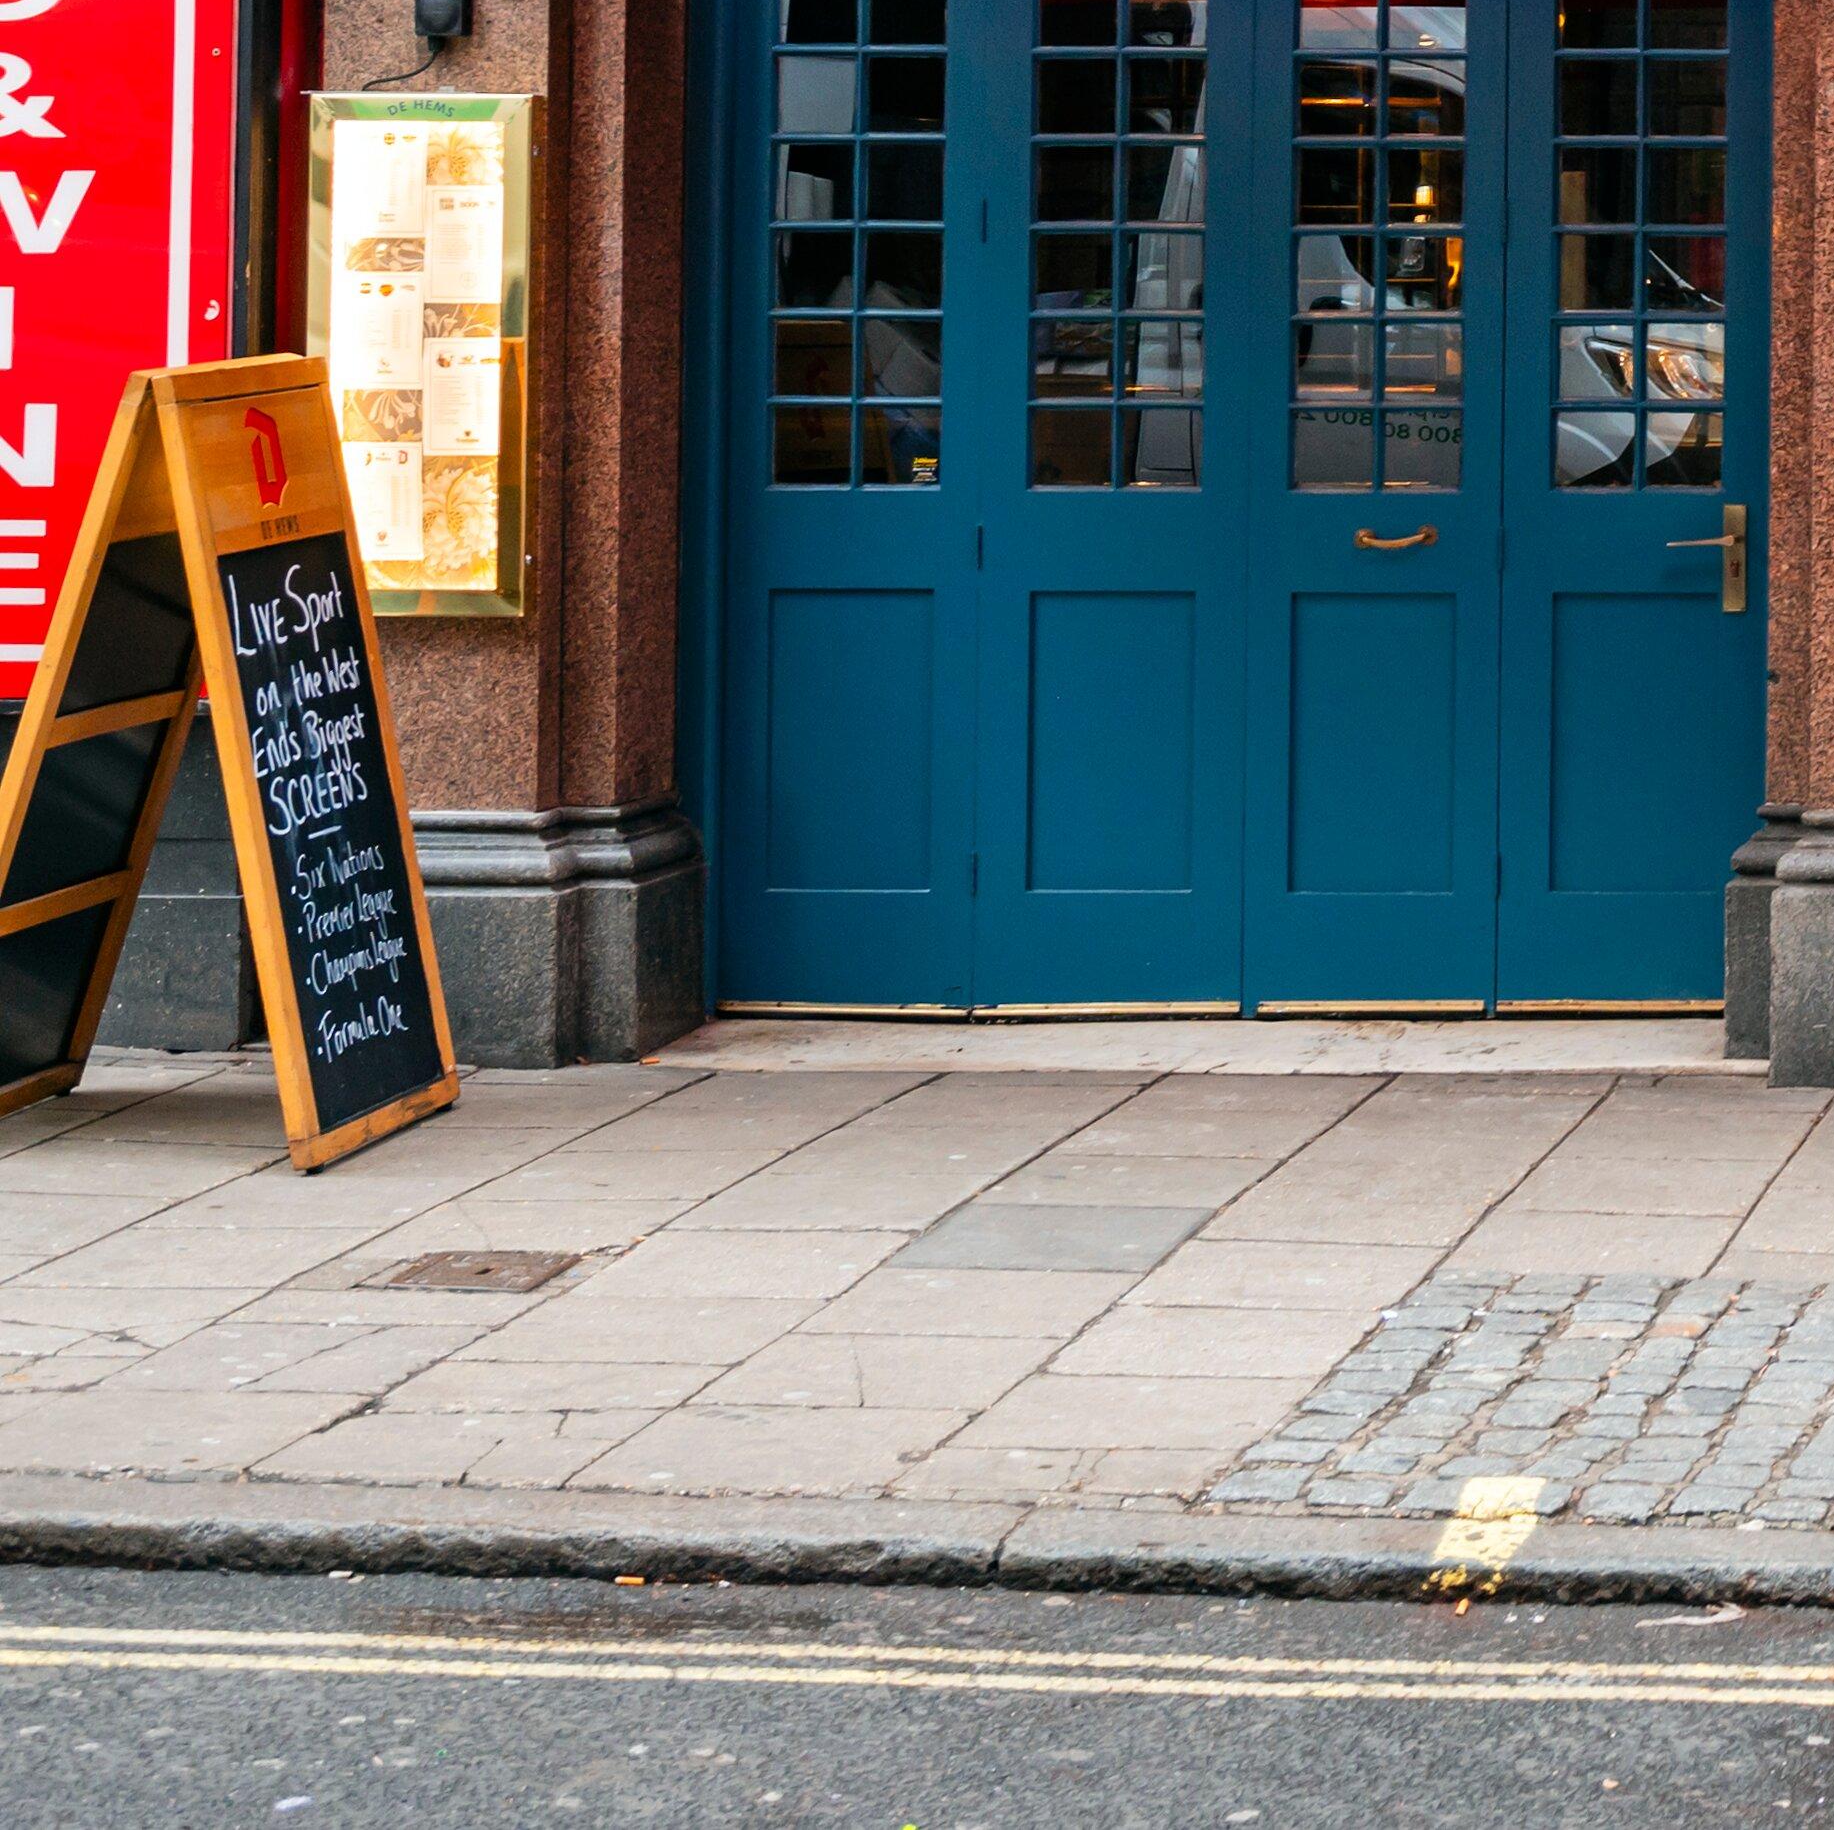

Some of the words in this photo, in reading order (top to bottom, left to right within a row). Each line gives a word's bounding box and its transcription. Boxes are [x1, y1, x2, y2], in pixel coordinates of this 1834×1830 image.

[387, 101, 407, 116] DE
[413, 99, 455, 117] HEMS
[284, 563, 344, 653] Sport
[255, 680, 282, 717] on
[290, 659, 324, 707] the
[322, 645, 361, 700] West
[301, 702, 366, 778] Biggest
[268, 762, 368, 836] SCREENS
[295, 852, 326, 901] Six
[326, 840, 385, 885] Nations
[354, 882, 398, 940] League
[369, 930, 408, 984] League
[317, 1001, 380, 1065] Formula
[378, 994, 410, 1036] One
